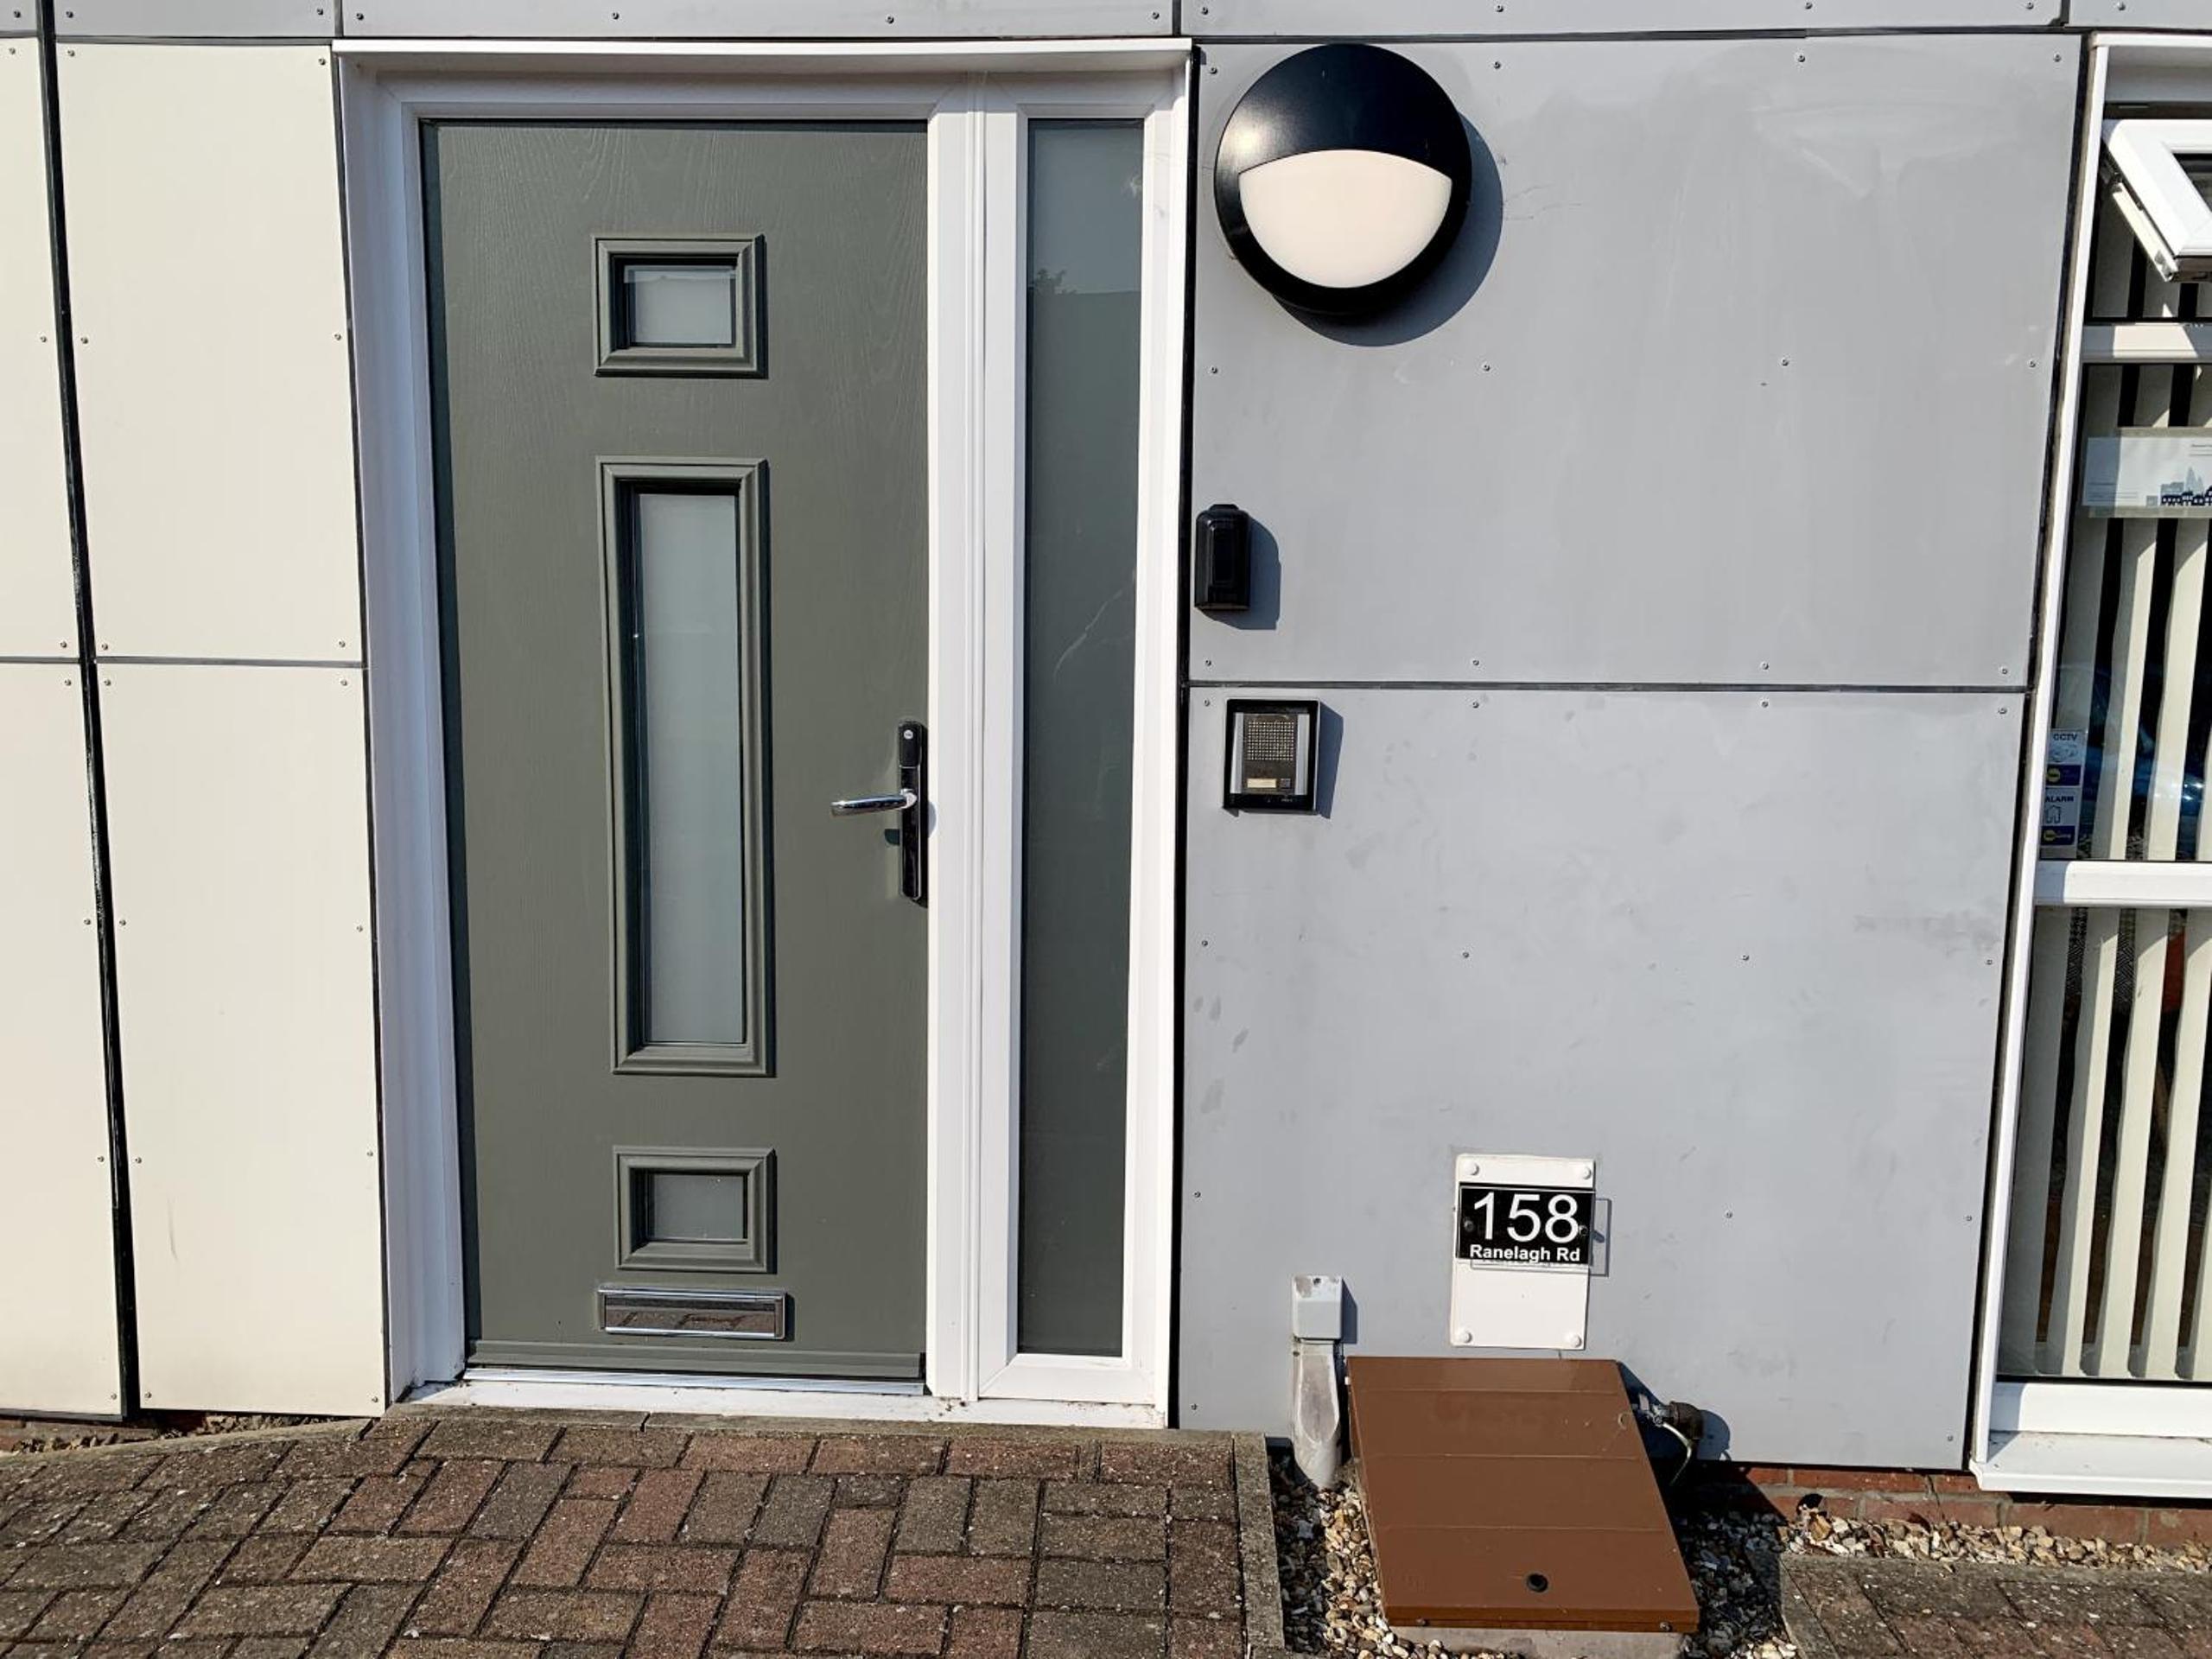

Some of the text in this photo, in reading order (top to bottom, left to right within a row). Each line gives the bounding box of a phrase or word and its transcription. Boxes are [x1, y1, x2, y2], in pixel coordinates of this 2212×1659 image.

[2052, 733, 2078, 741] CCTV
[2045, 795, 2075, 804] ALARM
[1473, 1191, 1580, 1244] 158
[1469, 1243, 1580, 1263] Ranelagh Rd
